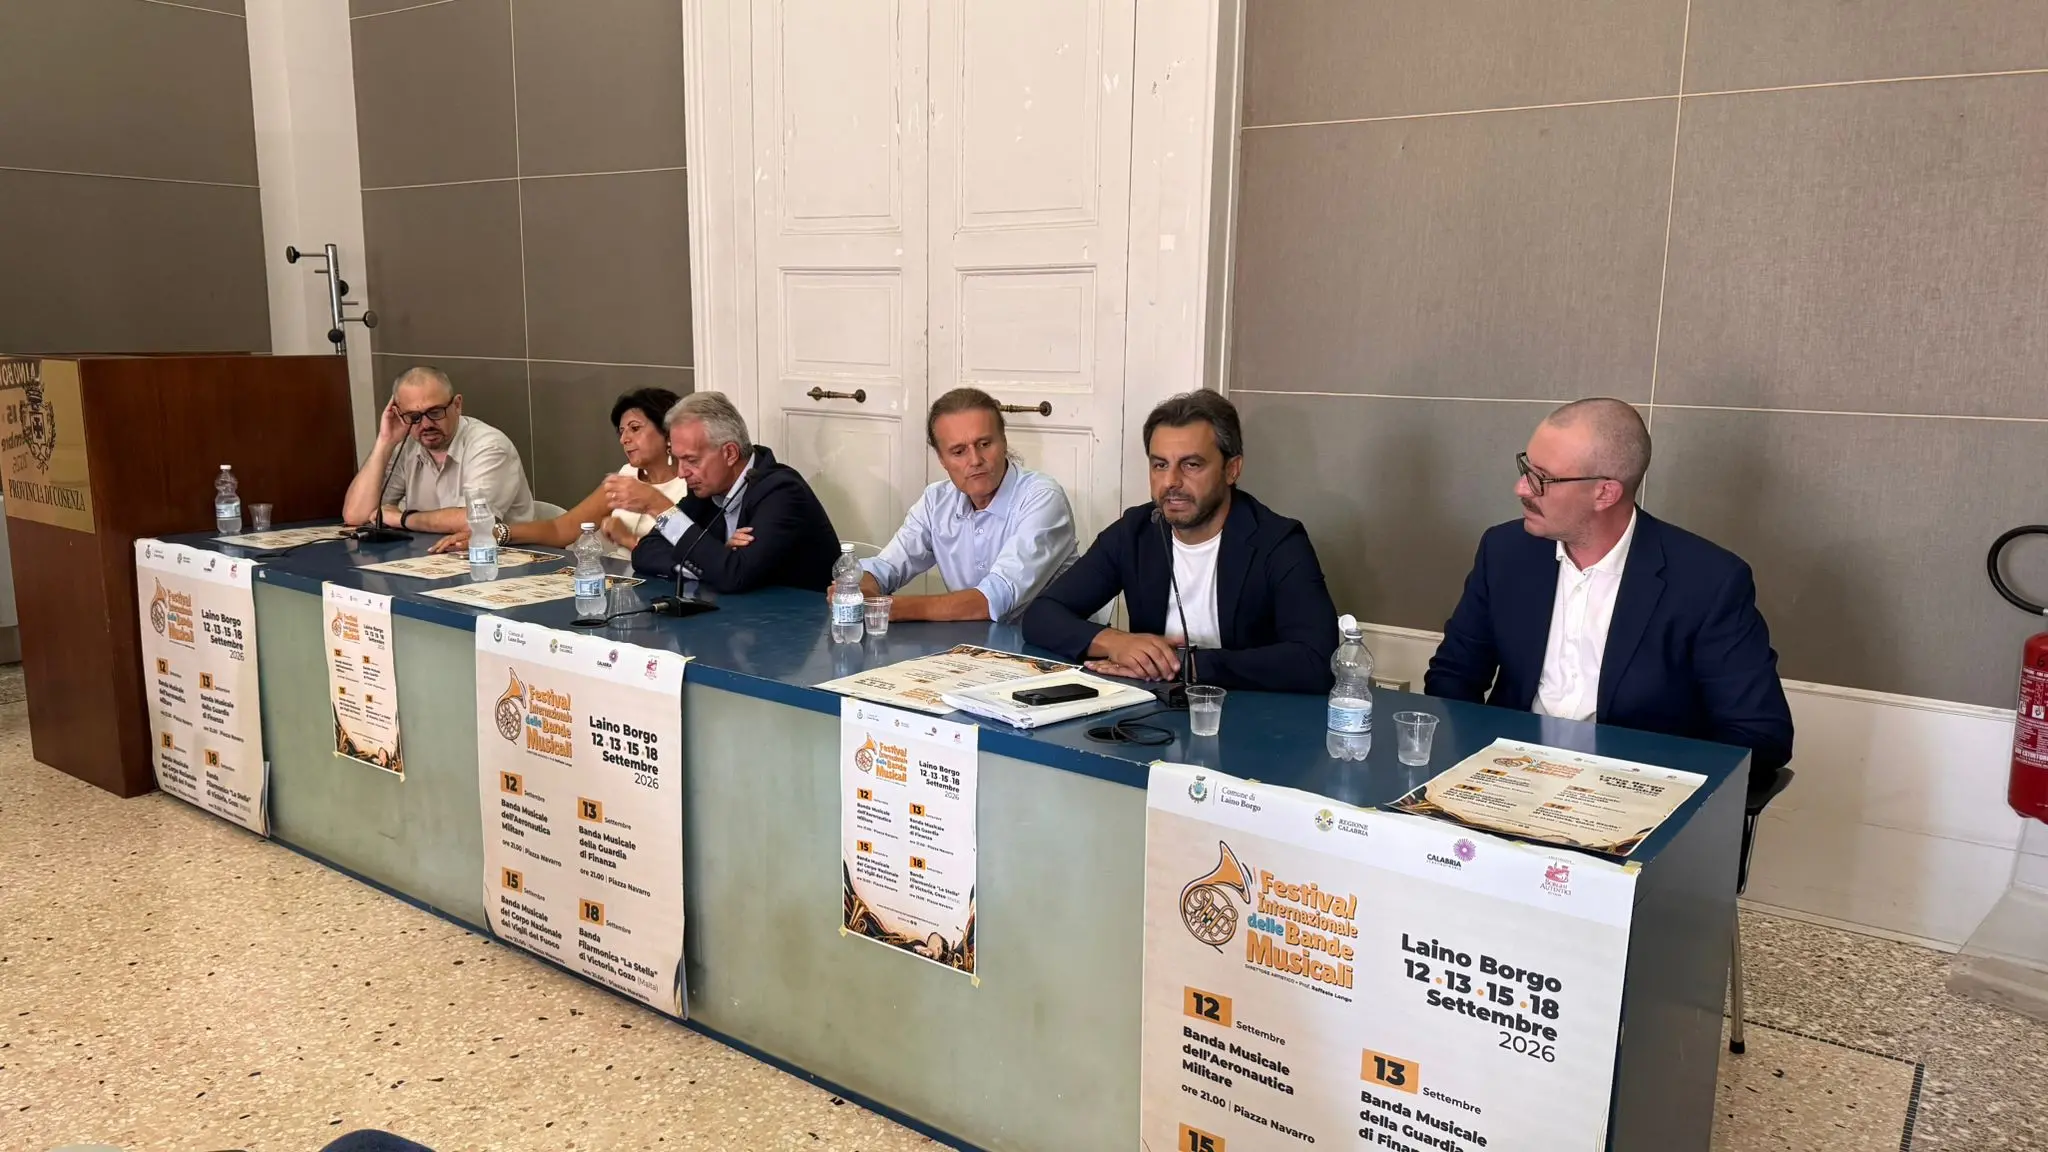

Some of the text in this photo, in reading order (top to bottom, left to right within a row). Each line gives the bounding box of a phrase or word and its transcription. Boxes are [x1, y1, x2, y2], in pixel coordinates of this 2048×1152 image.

[9, 479, 85, 511] PROVINCIA DI COSENZA
[202, 609, 241, 627] Laino Borgo
[203, 622, 242, 640] 12 13 15 18
[211, 635, 243, 650] Settembre
[202, 675, 210, 688] 13
[529, 684, 571, 711] Festival
[542, 720, 571, 739] Bande
[589, 715, 657, 744] Laino Borgo
[526, 729, 573, 758] Musicali
[592, 732, 658, 761] 12 13 15 18
[879, 742, 907, 757] Festival
[603, 751, 658, 775] Settembre
[876, 766, 907, 782] Musicali
[919, 760, 960, 777] Laino Borgo
[504, 774, 545, 803] 12 Settembre
[634, 773, 659, 789] 2026
[920, 769, 960, 786] 12 13 15 18
[926, 779, 959, 793] Settembre
[860, 789, 868, 799] 12
[945, 791, 959, 800] 2026
[1221, 786, 1256, 801] Comune di
[1221, 795, 1261, 812] Laino Borgo
[501, 799, 548, 823] Banda Musicale
[583, 800, 631, 830] 13 Settembre
[912, 804, 921, 815] 13
[501, 811, 550, 836] dell'Aeronautica
[502, 822, 524, 838] Militare
[1338, 819, 1368, 830] REGIONE
[1338, 825, 1368, 837] CALABRIA
[579, 825, 636, 851] Banda Musicale
[579, 838, 627, 861] della Guardia
[860, 842, 869, 851] 15
[502, 840, 510, 848] ore
[525, 848, 540, 860] Piazza
[541, 854, 562, 868] Navarro
[580, 850, 616, 869] di Finanza
[913, 857, 922, 868] 18
[1427, 854, 1461, 867] CALABRIA
[506, 871, 545, 902] 15 Settembre
[580, 868, 650, 897] ore 21.00 Piazza Navarro
[1260, 869, 1358, 920] Festival
[501, 895, 548, 922] Banda Musicale
[584, 902, 631, 934] 18 Settembre
[1257, 893, 1358, 939] Internazionale
[501, 907, 562, 940] del Corpo Nazionale
[511, 922, 528, 937] Vigili
[529, 931, 539, 941] del
[540, 935, 559, 950] Fuoco
[579, 927, 601, 943] Banda
[1247, 913, 1354, 961] delle Bande
[578, 939, 658, 978] Filarmonica "La Stella"
[1246, 929, 1353, 989] Musicali
[1402, 933, 1562, 993] Laino Borgo
[579, 952, 658, 992] di Victoria, Gozo (Malta)
[1311, 985, 1334, 997] Raffaele
[1334, 991, 1352, 1003] Longo
[1404, 959, 1559, 1020] 12 13 15 18
[1193, 992, 1286, 1046] 12 Settembre
[1426, 989, 1558, 1042] Settembre
[1183, 1026, 1290, 1075] Banda Musicale
[1499, 1031, 1556, 1063] 2026
[1182, 1044, 1294, 1096] dell'Aeronautica
[1182, 1060, 1232, 1088] Militare
[1374, 1055, 1481, 1114] 13 Settembre
[1181, 1083, 1315, 1144] ore 21.00 Piazza Navarro
[1361, 1090, 1487, 1148] Banda Musicale
[1188, 1129, 1215, 1152] 15
[1359, 1127, 1373, 1141] di
[1360, 1109, 1464, 1152] della Guardia
